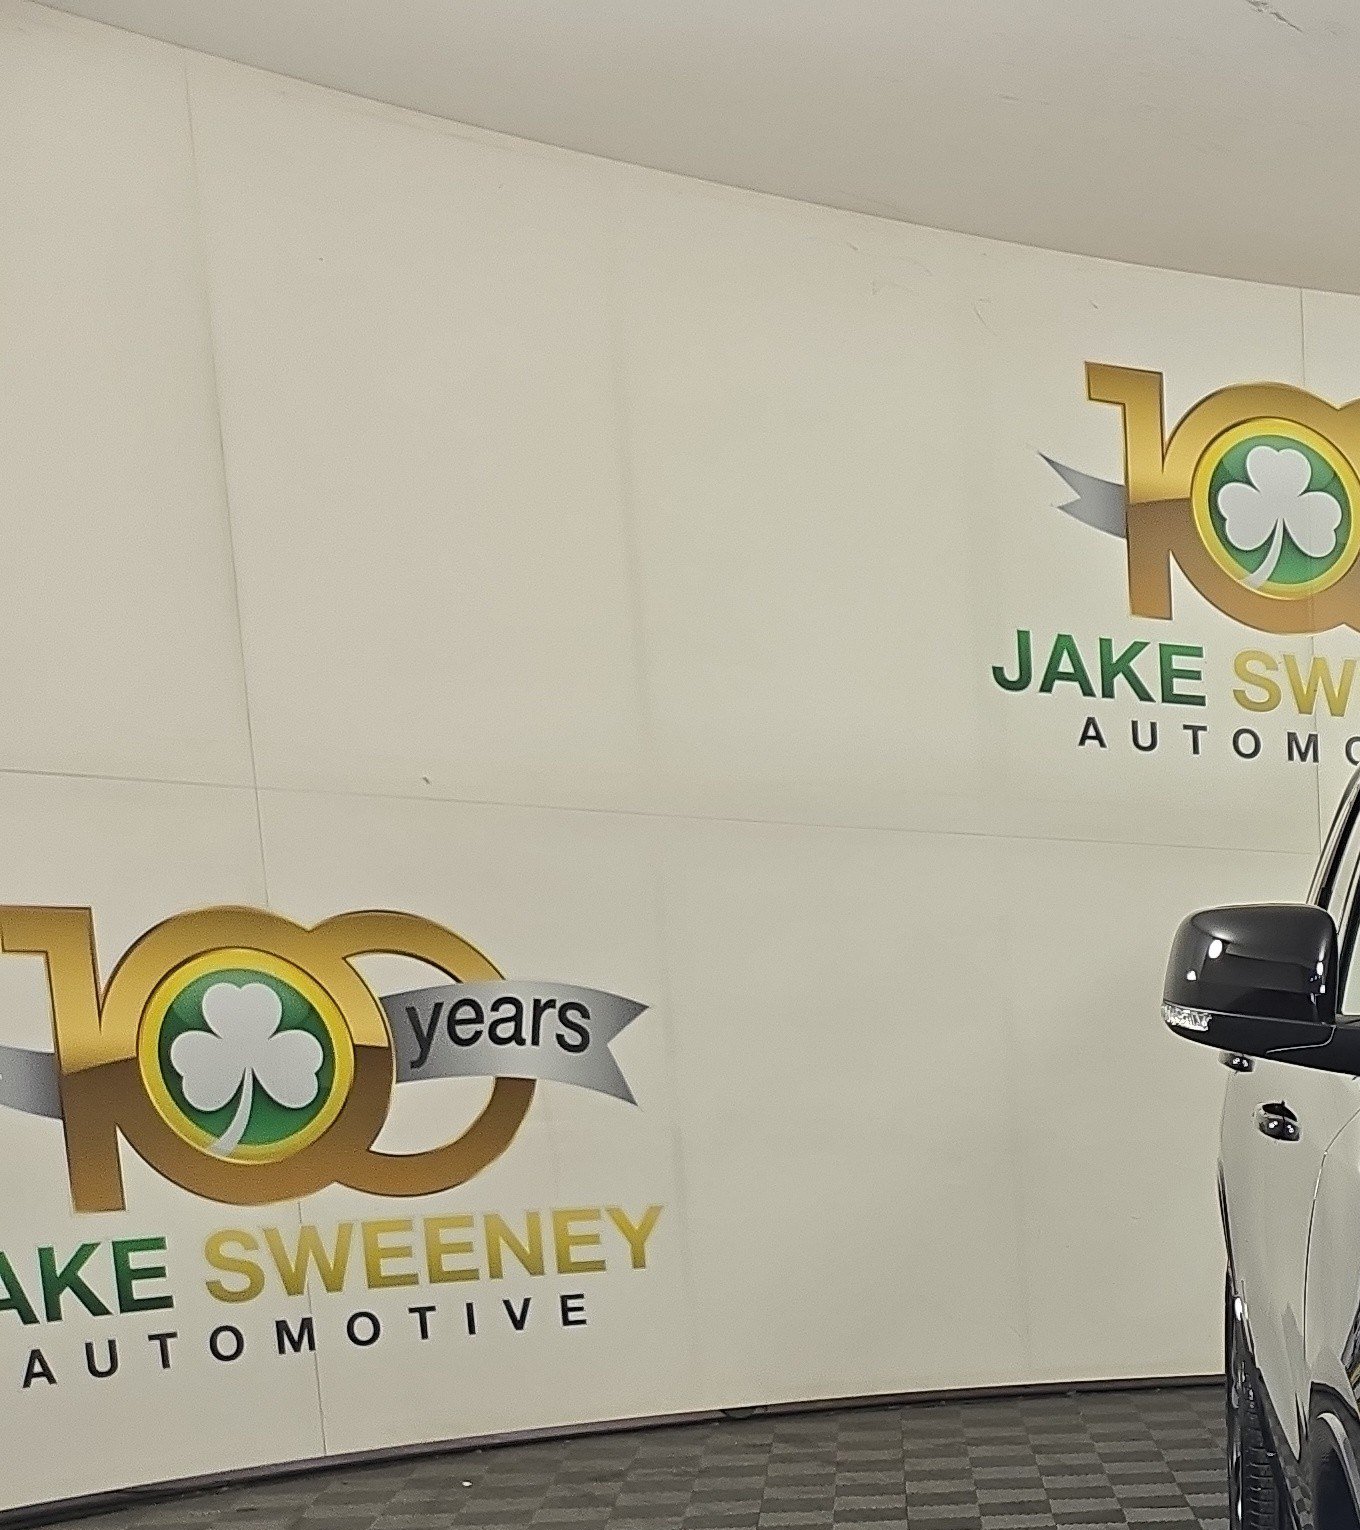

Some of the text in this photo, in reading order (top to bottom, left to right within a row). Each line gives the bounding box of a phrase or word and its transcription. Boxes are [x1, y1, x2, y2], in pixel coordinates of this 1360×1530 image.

[991, 629, 1207, 707] JAKE
[405, 995, 591, 1068] years
[0, 1205, 664, 1325] AKE SWEENEY
[22, 1294, 588, 1388] AUTOMOTIVE
